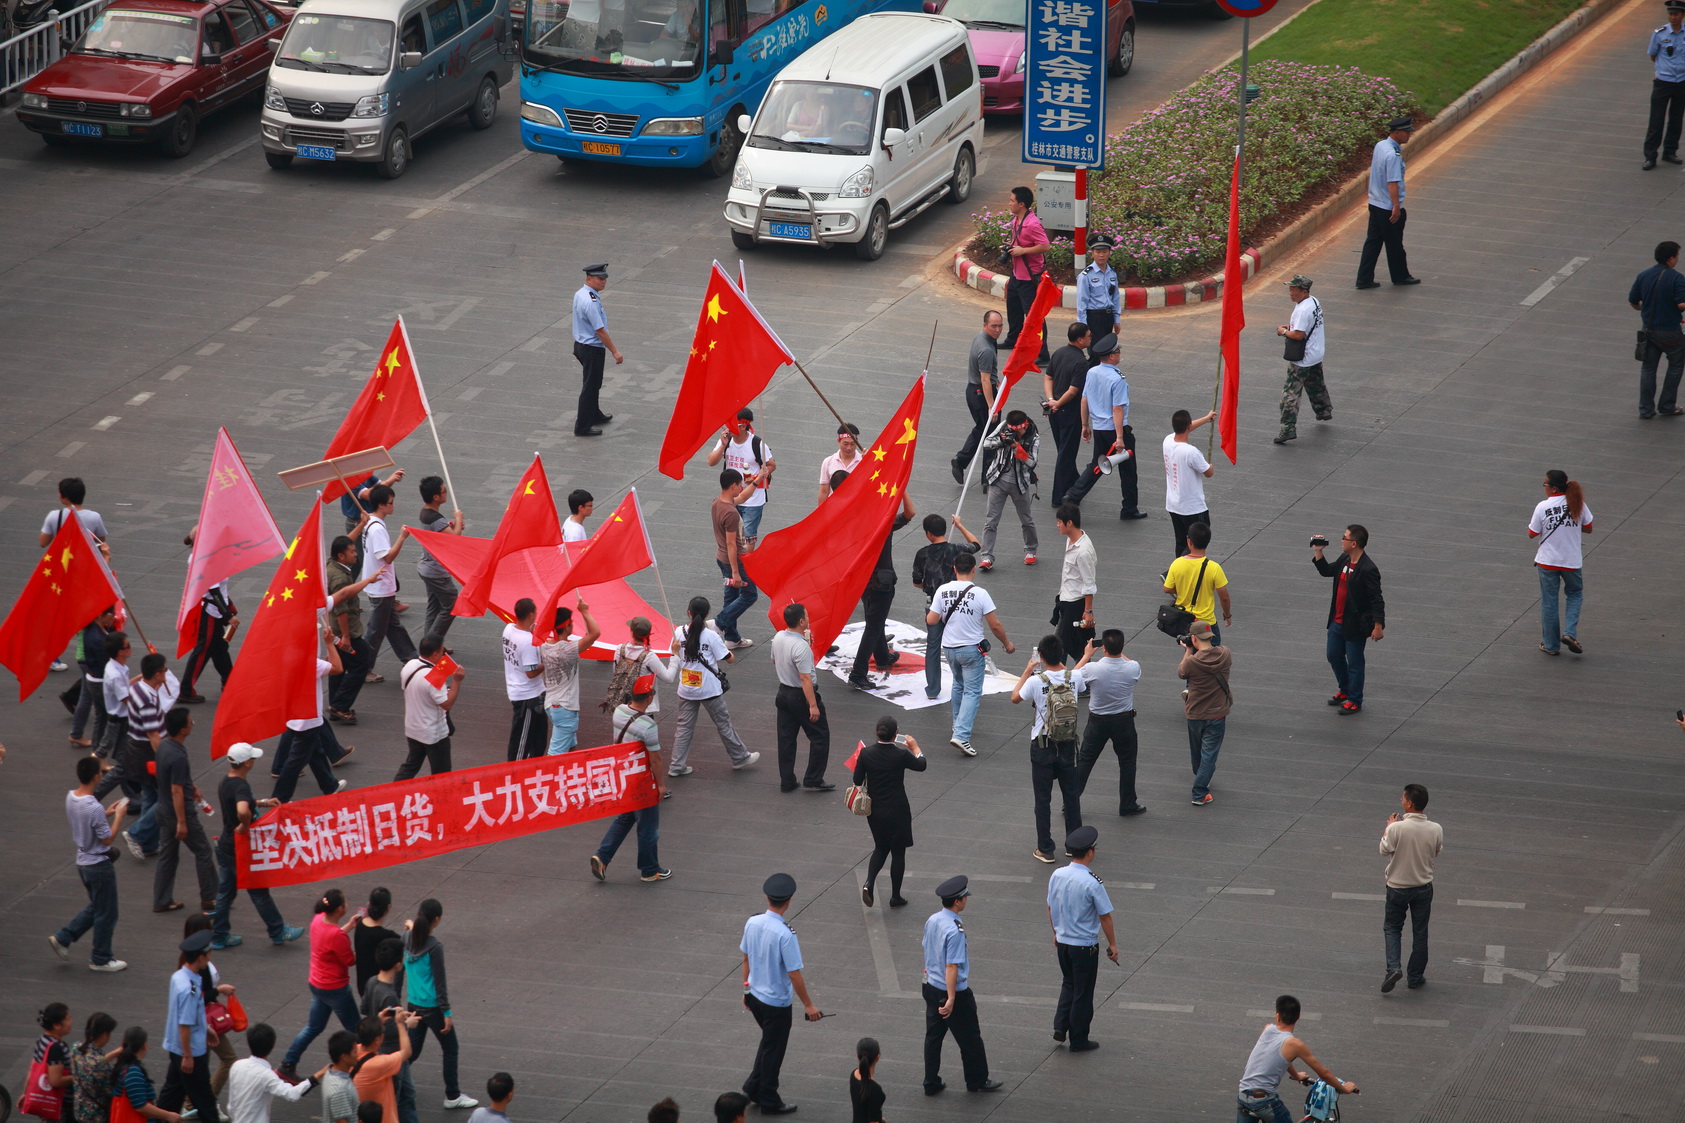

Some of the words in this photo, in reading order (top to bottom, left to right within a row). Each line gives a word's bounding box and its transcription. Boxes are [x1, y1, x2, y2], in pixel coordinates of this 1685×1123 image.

[1032, 141, 1095, 161] 桂林市交通警察支队
[1549, 512, 1573, 523] FUK
[943, 606, 973, 615] JPAN
